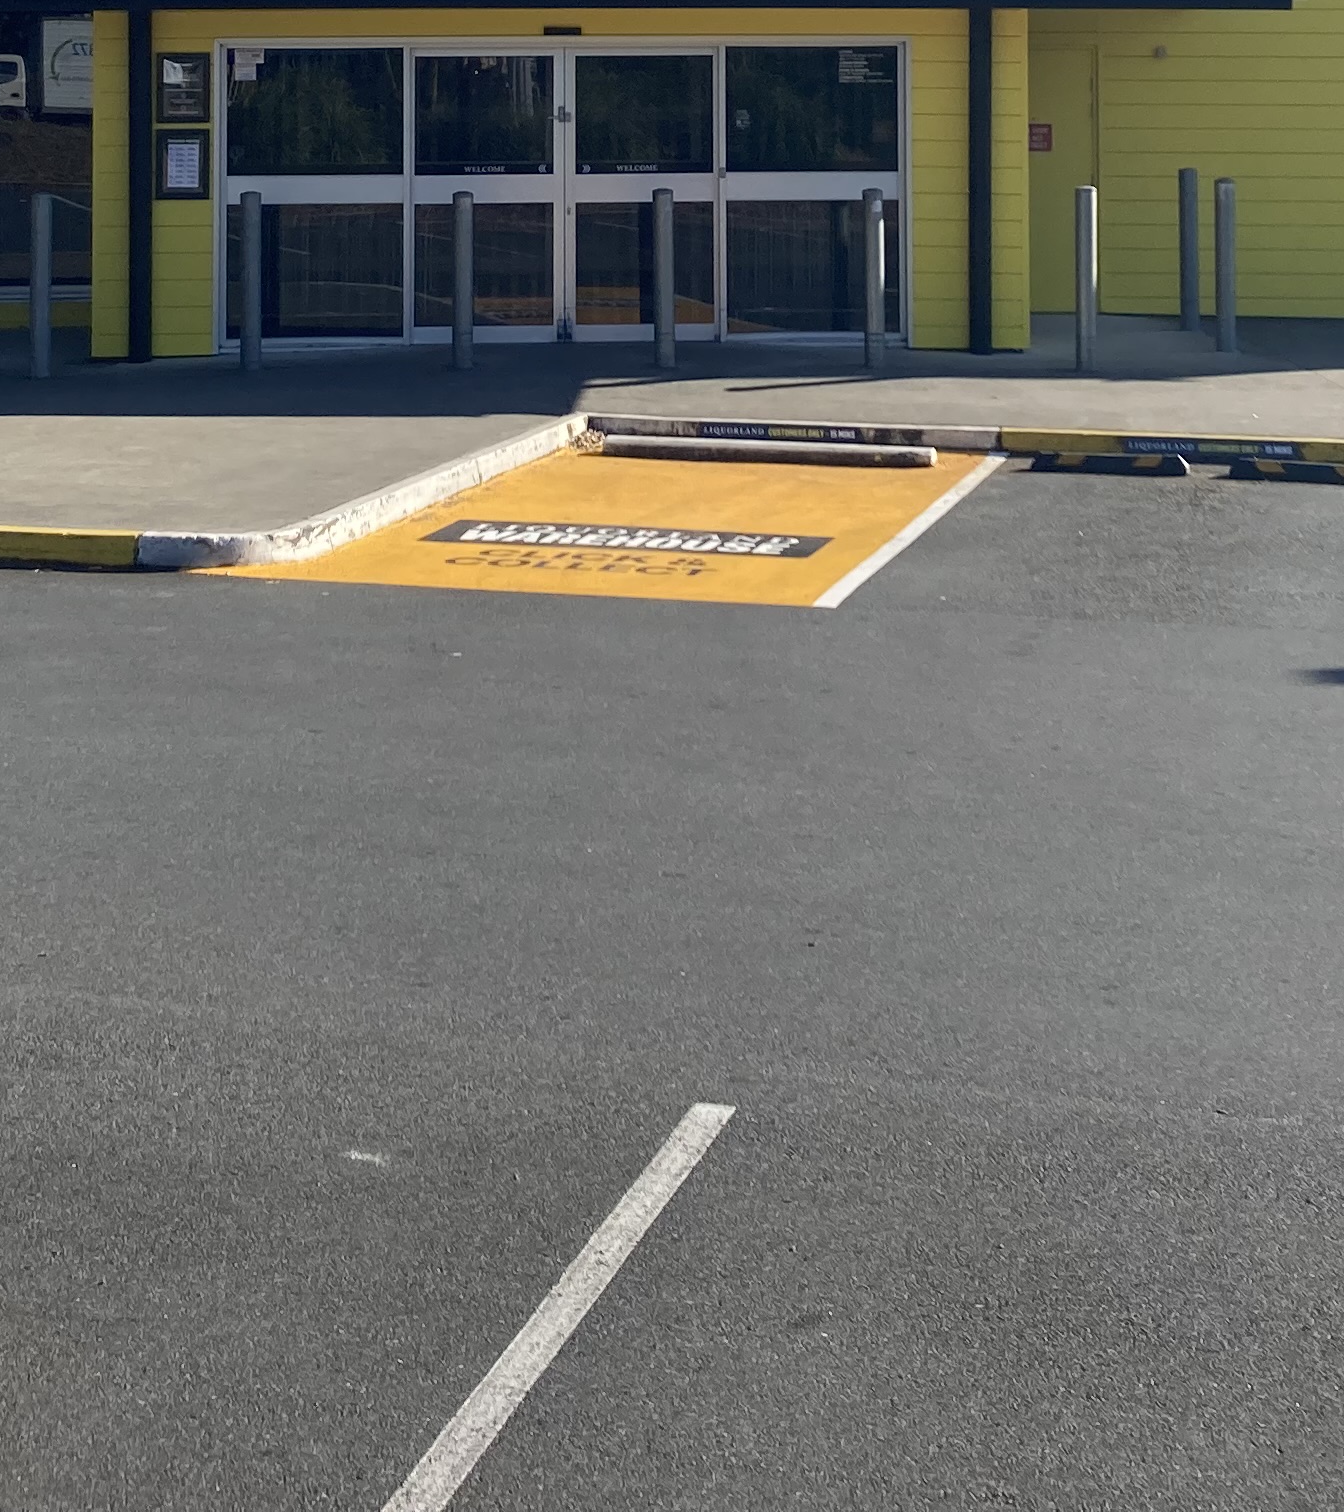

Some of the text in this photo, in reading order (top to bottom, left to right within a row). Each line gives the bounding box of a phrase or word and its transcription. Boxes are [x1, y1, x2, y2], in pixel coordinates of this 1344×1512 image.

[464, 165, 505, 173] WELCOME
[616, 164, 658, 172] WELCOME
[703, 425, 765, 436] LIQUORLAND
[1128, 440, 1195, 452] LIQUORLAND
[474, 522, 800, 545] LIQUORLAND
[459, 528, 790, 555] WAREHOUSE
[479, 548, 651, 565] CLICK
[445, 555, 719, 577] COLLECT
